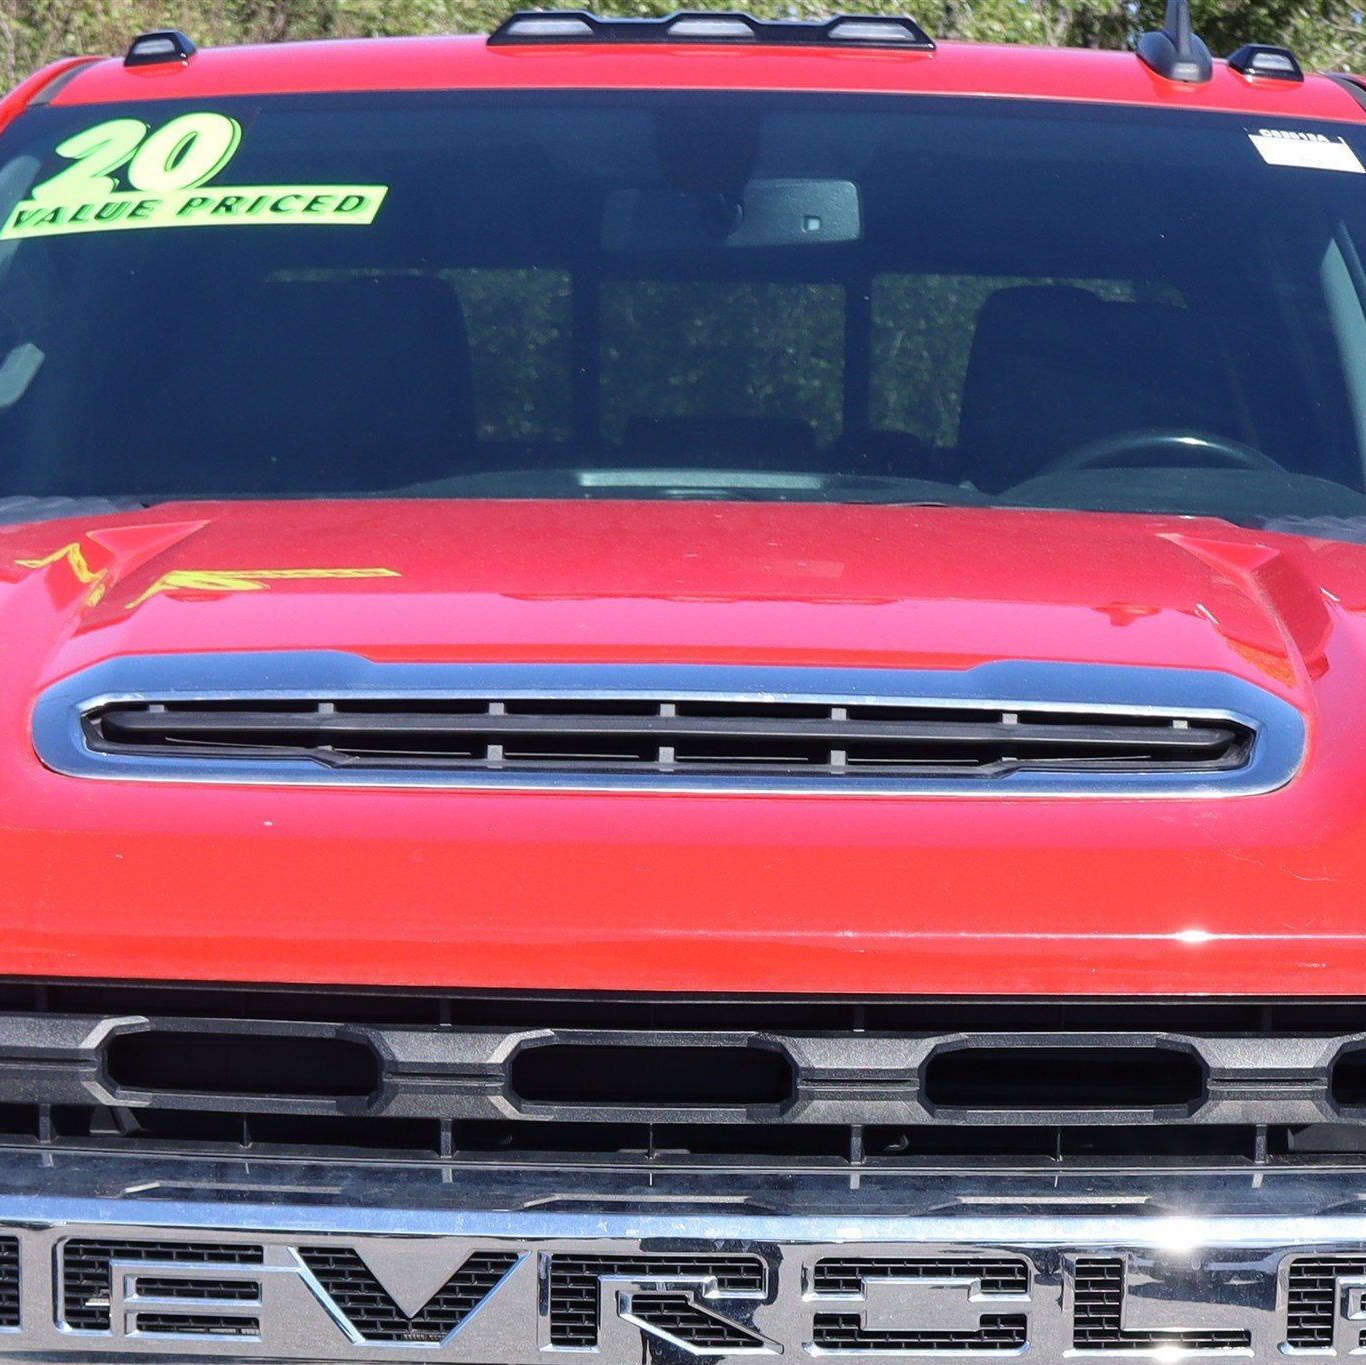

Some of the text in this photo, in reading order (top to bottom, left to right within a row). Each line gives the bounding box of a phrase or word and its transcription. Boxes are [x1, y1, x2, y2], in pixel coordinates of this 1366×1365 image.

[31, 111, 242, 201] 20
[12, 194, 370, 230] VALUE PRICED
